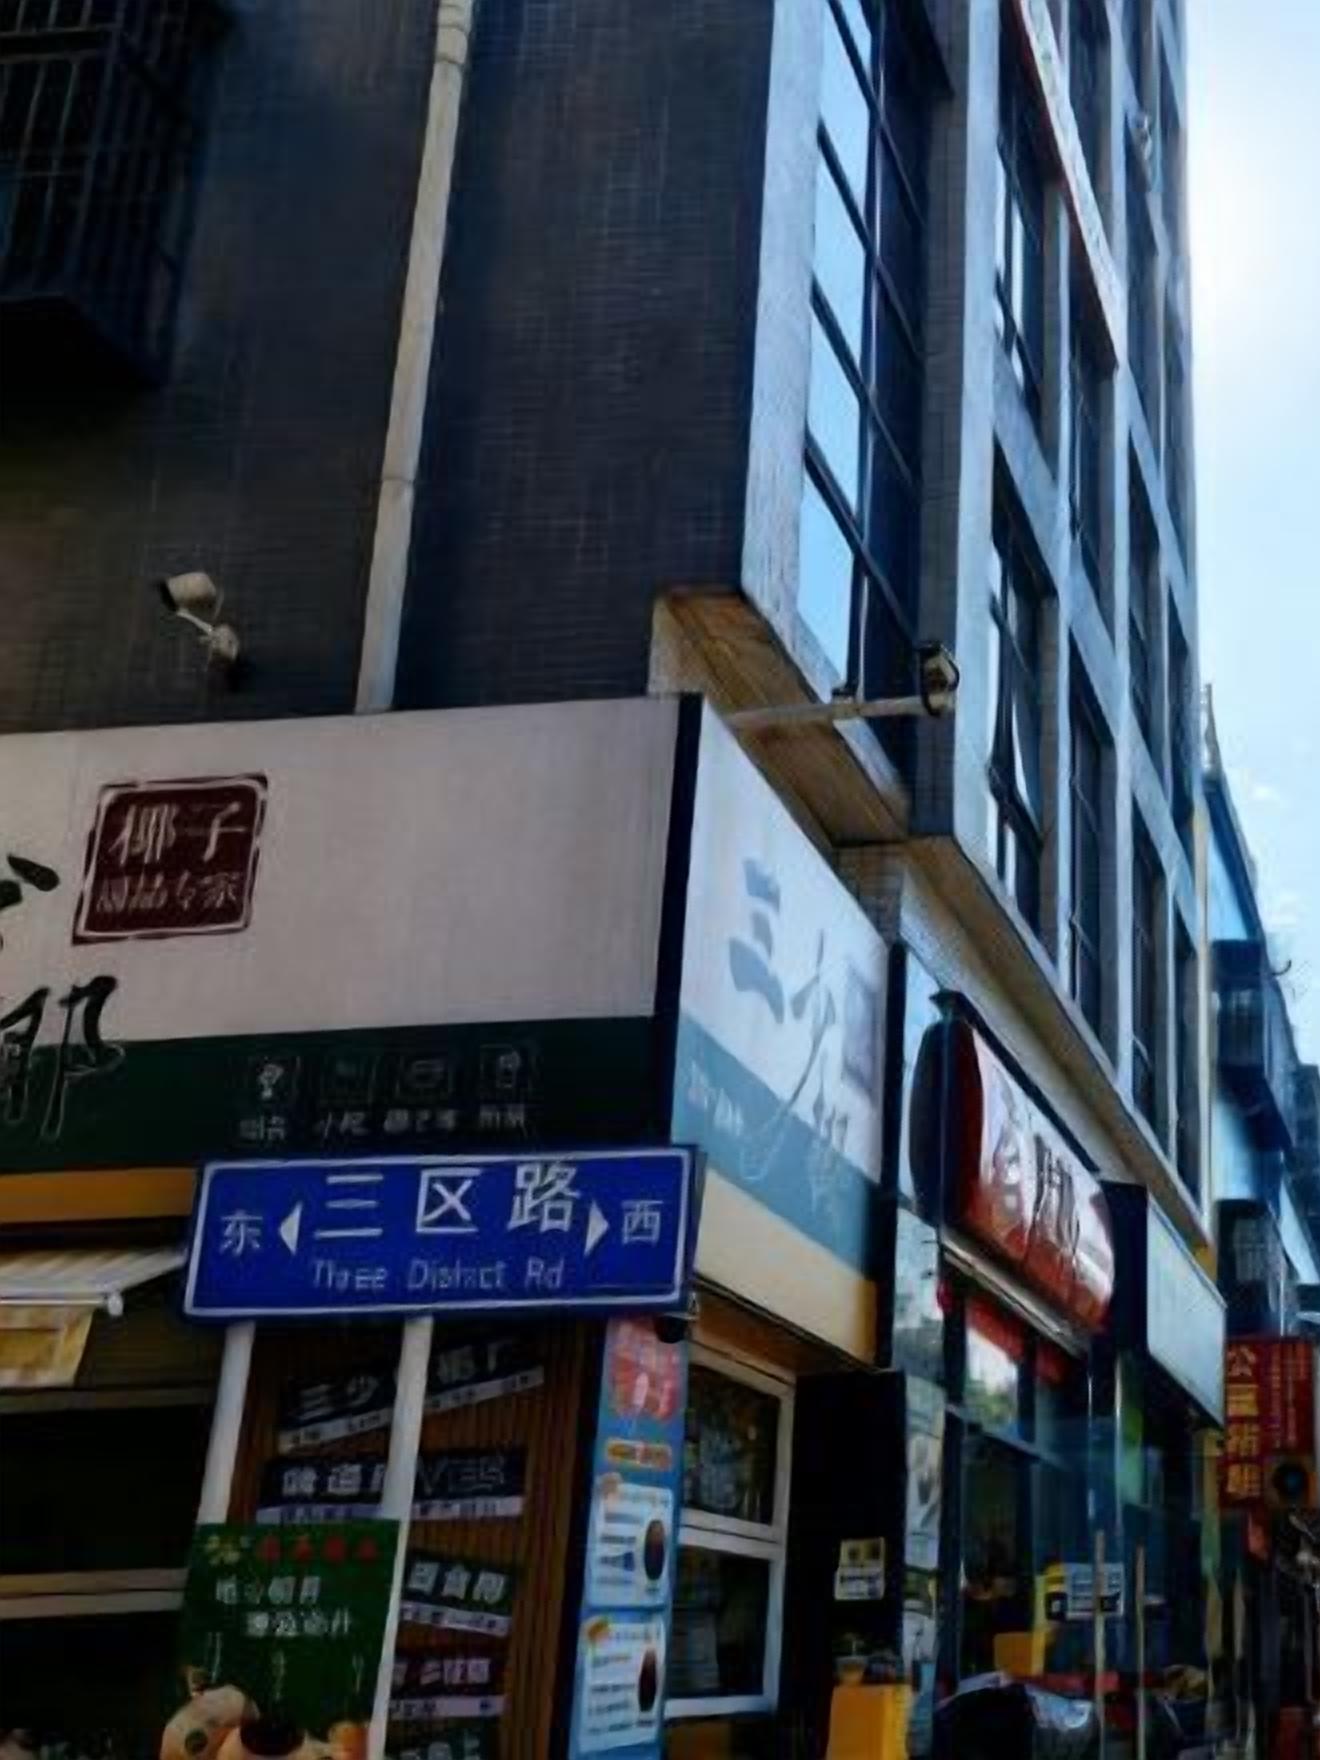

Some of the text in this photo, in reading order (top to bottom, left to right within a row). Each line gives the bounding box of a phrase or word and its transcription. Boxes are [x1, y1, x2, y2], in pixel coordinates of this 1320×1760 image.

[314, 1162, 582, 1240] 三区路
[620, 1200, 664, 1247] 西
[218, 1209, 264, 1257] 东
[312, 1256, 565, 1291] Three District Rd
